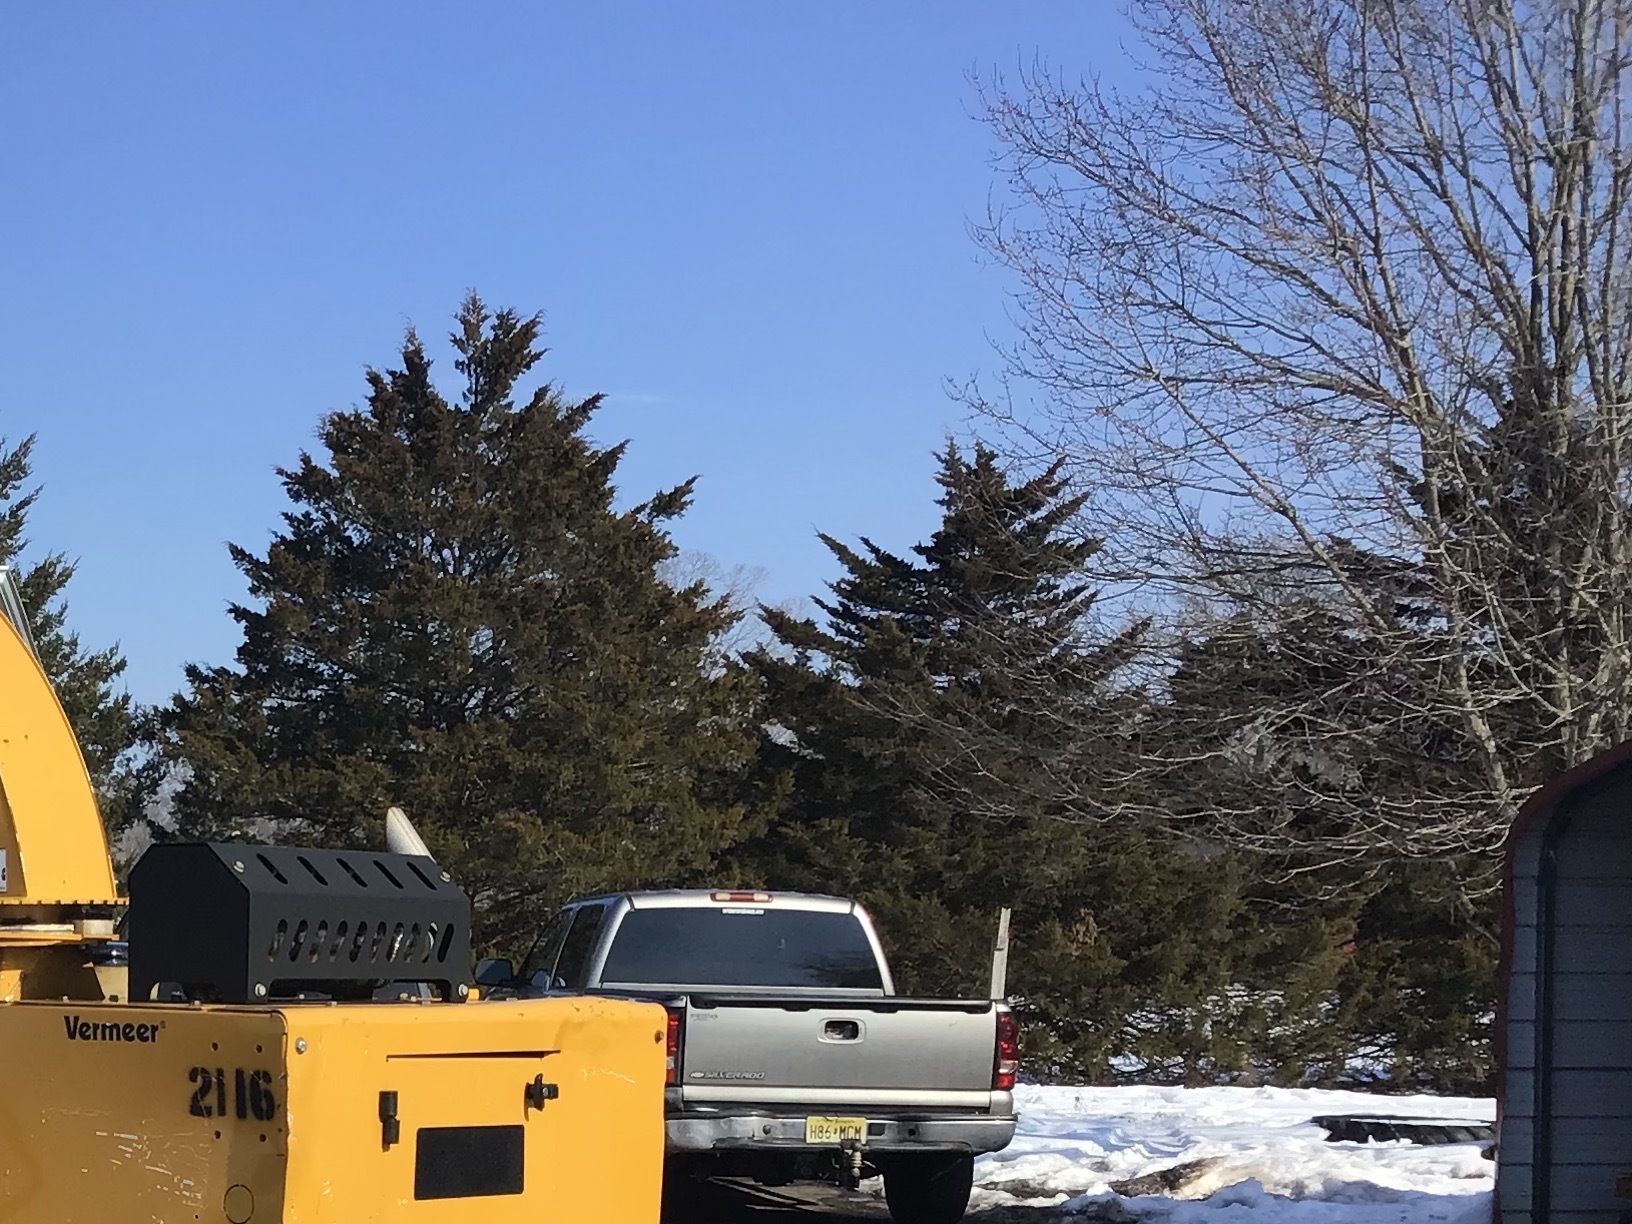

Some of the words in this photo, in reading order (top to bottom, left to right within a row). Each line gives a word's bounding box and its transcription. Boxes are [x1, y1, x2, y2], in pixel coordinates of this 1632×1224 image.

[64, 1016, 159, 1043] Vermeer
[705, 1072, 765, 1080] SILVERADO
[189, 1067, 275, 1121] 2116
